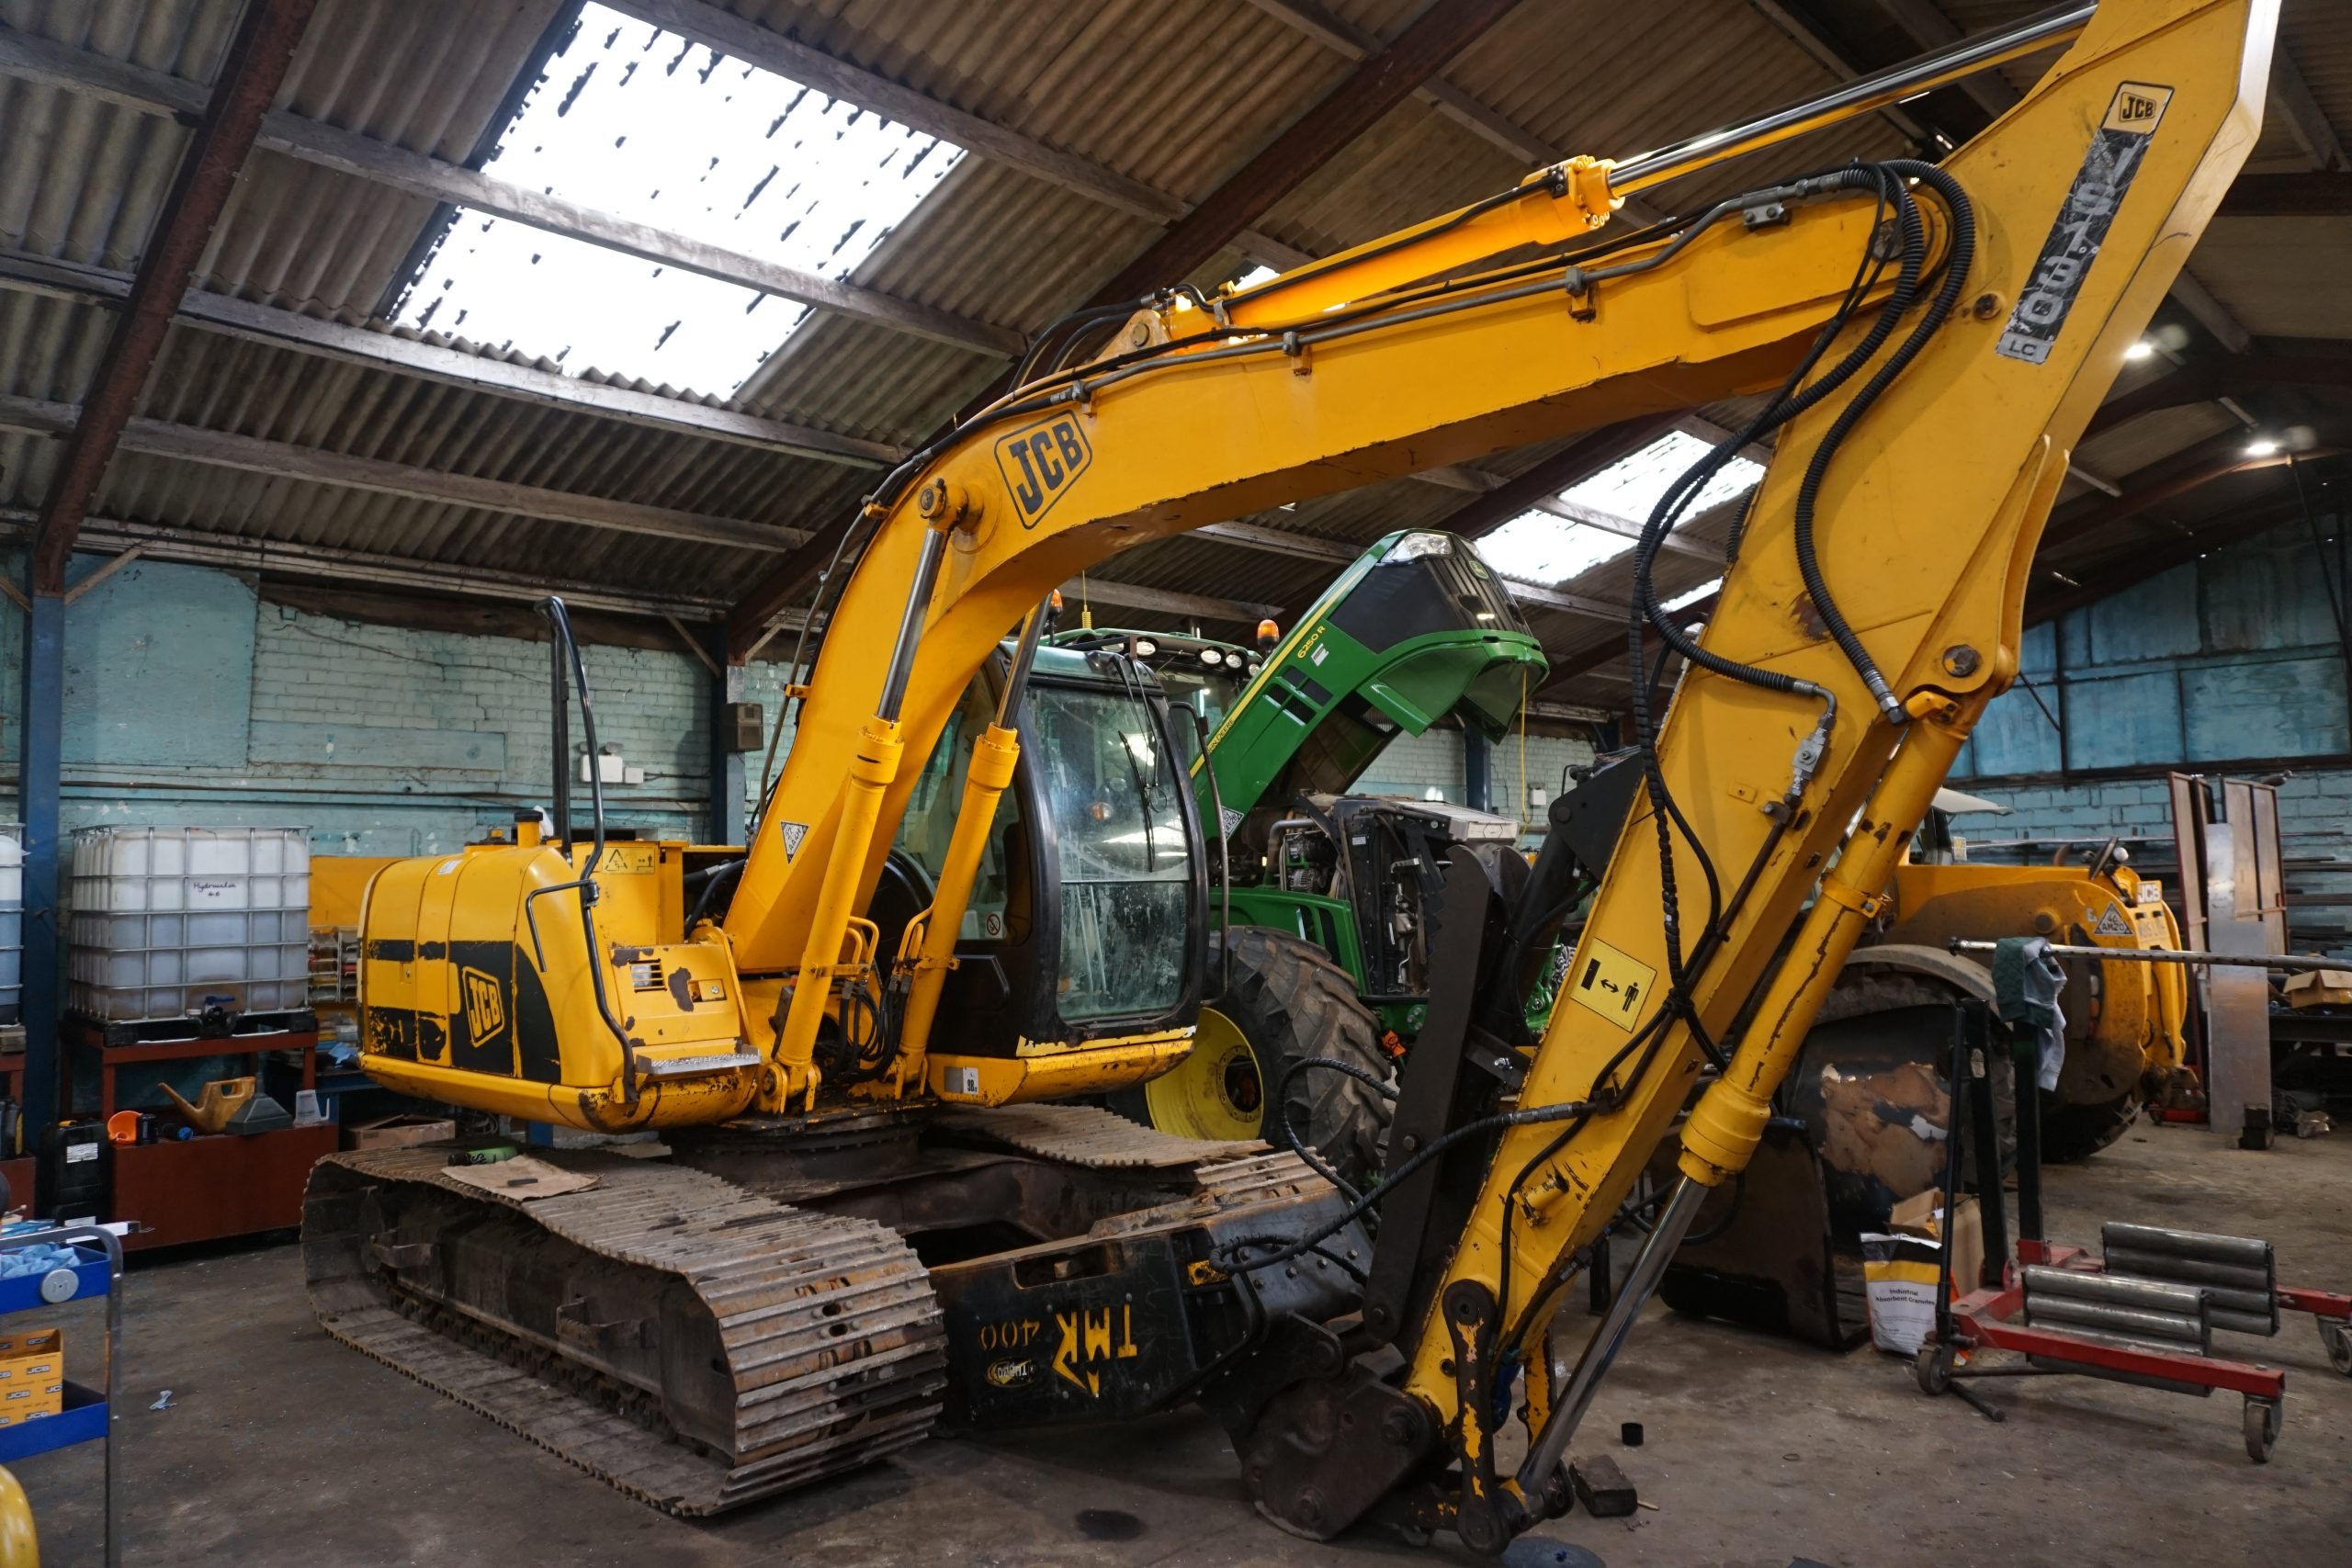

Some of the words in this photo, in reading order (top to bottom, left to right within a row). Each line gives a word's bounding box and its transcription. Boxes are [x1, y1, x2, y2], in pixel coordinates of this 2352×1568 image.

[2121, 96, 2155, 119] JCB
[2008, 341, 2037, 356] LC
[1008, 421, 1083, 515] JCB
[1297, 634, 1318, 659] 6250
[1317, 626, 1326, 634] R
[1217, 719, 1235, 740] DEERE
[2136, 883, 2161, 904] JCB
[469, 976, 502, 1039] JCB
[1889, 1288, 1918, 1296] Industrial
[1908, 1297, 1935, 1305] Granules
[980, 1318, 1040, 1350] 400
[1052, 1303, 1137, 1391] TMK
[27, 1365, 51, 1374] JCB
[6, 1390, 30, 1400] JCB
